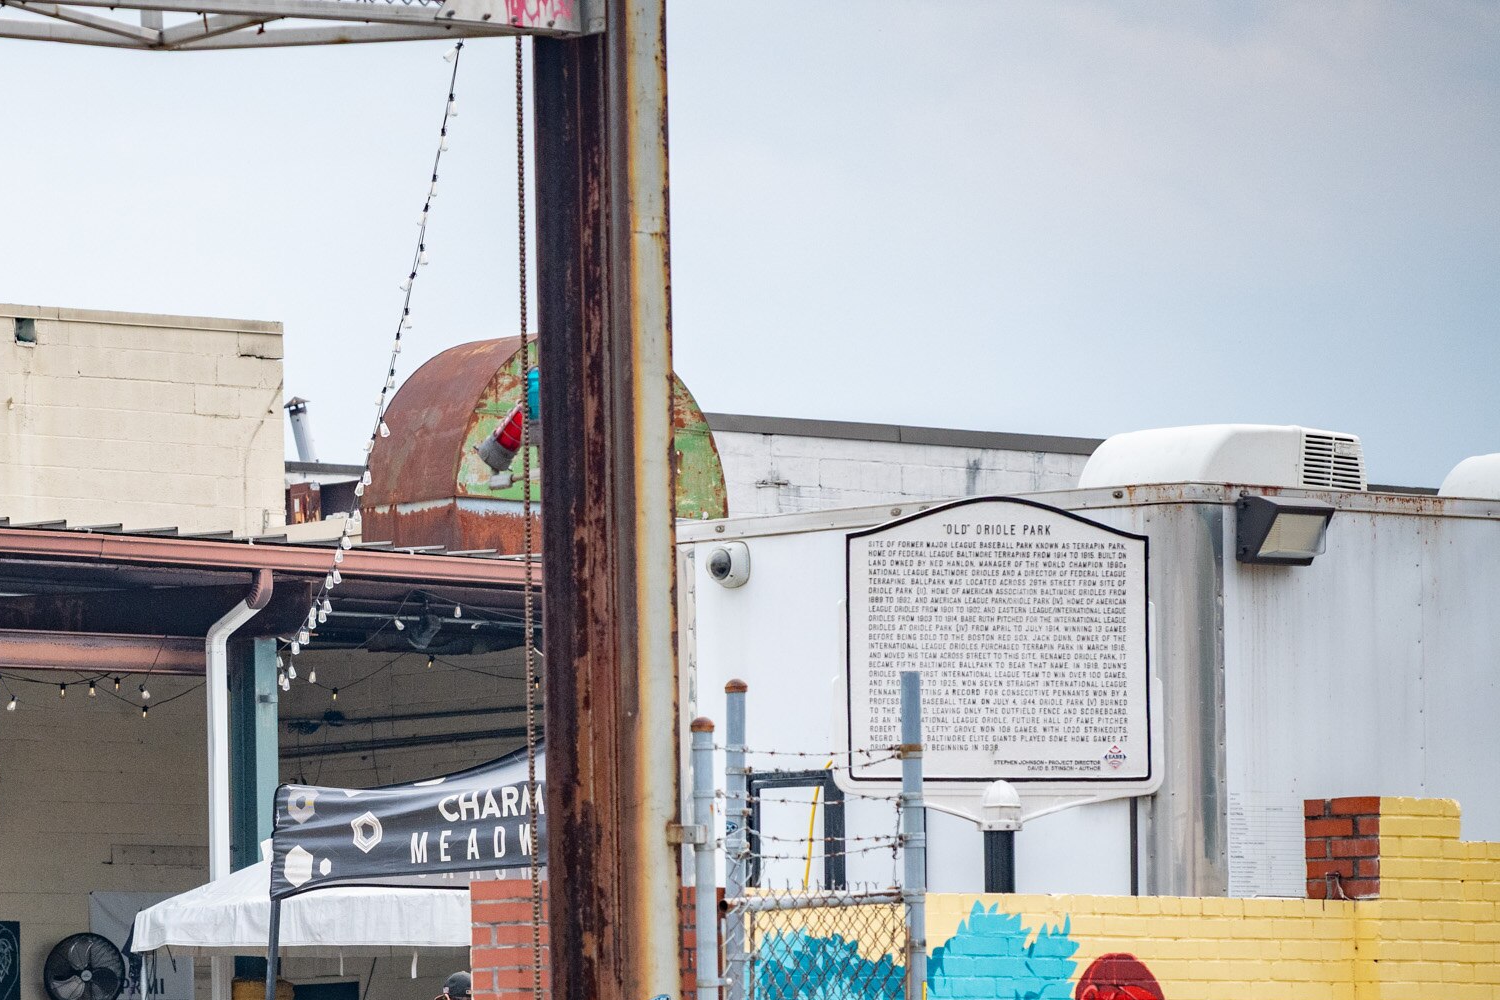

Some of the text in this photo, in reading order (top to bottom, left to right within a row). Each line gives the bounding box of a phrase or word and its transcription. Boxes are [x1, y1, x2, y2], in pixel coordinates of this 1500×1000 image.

[976, 524, 1015, 535] ORIOLE
[1023, 525, 1051, 535] PARK
[439, 783, 545, 822] CHARM
